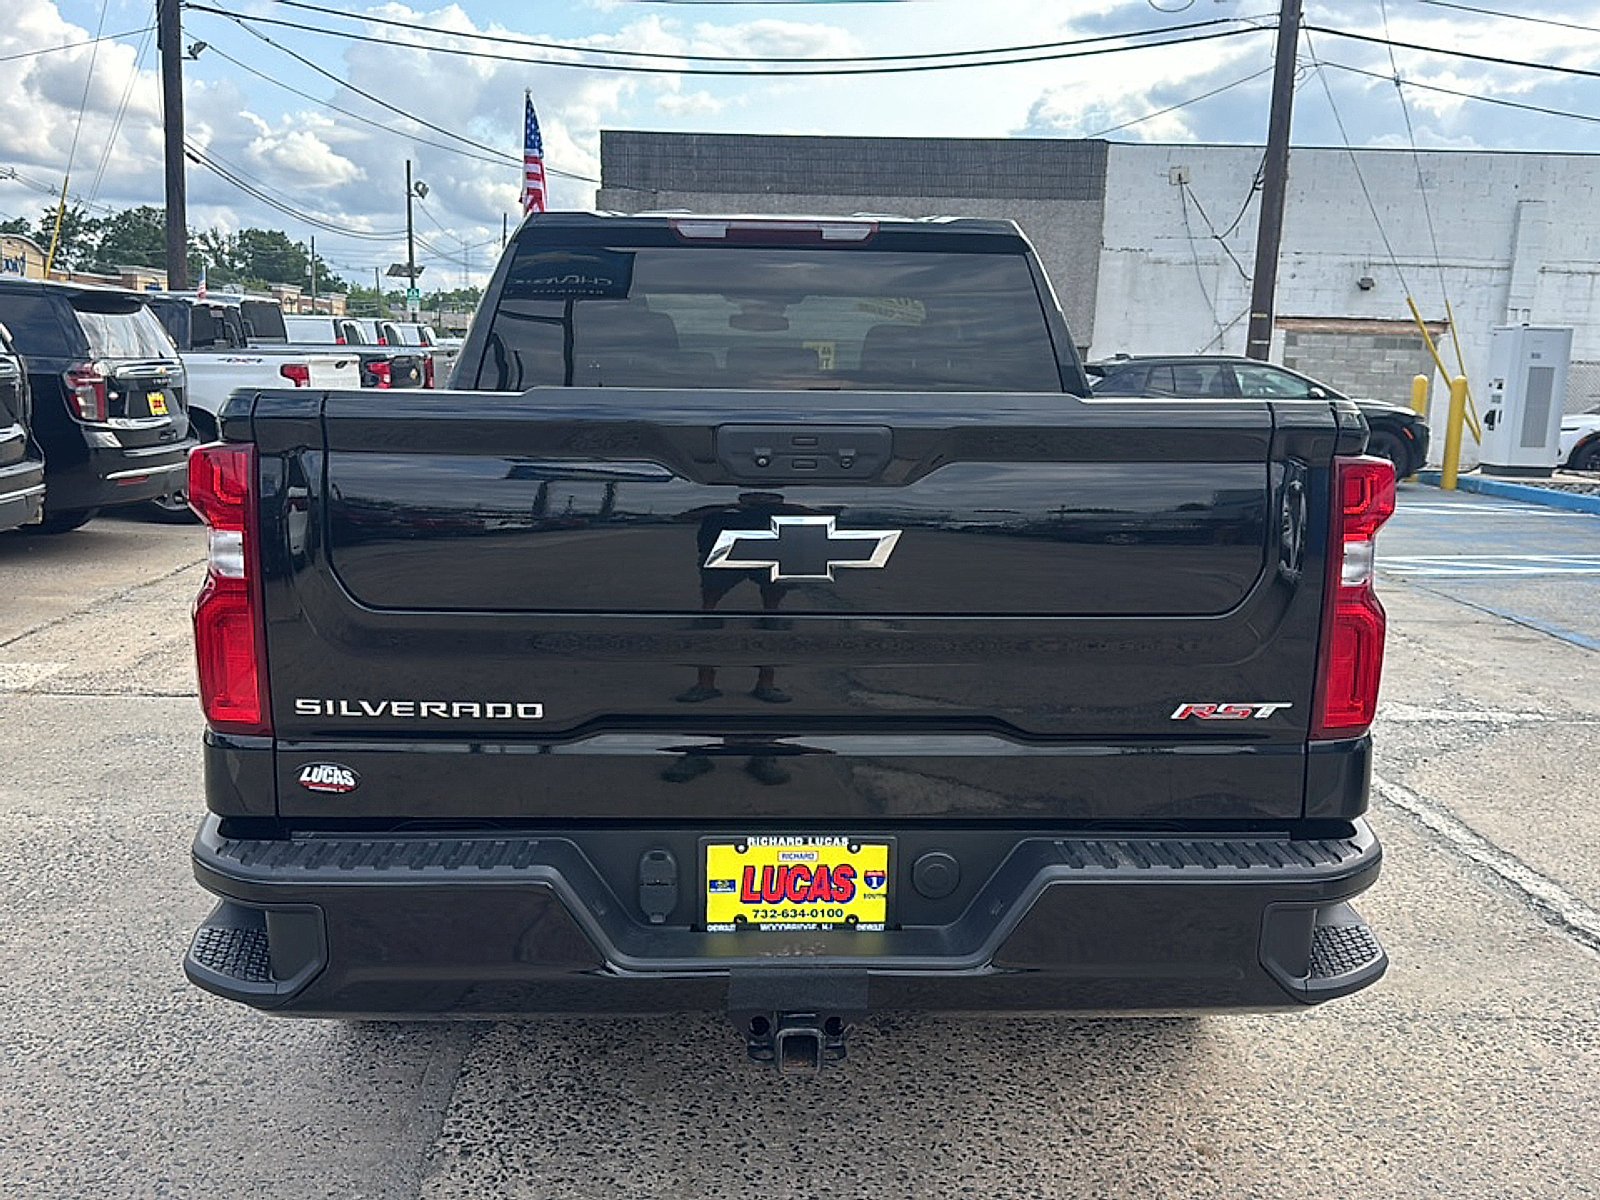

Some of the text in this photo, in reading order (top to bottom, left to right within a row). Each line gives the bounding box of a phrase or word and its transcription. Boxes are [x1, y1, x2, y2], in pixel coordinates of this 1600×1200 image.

[295, 698, 543, 719] SILVERADO
[1170, 702, 1293, 720] RST
[299, 766, 356, 786] LUCAS
[747, 836, 850, 847] RICHARD LUCAS
[781, 852, 815, 860] RICHARD
[740, 864, 858, 904] LUCAS
[751, 908, 844, 919] 732-634-0100
